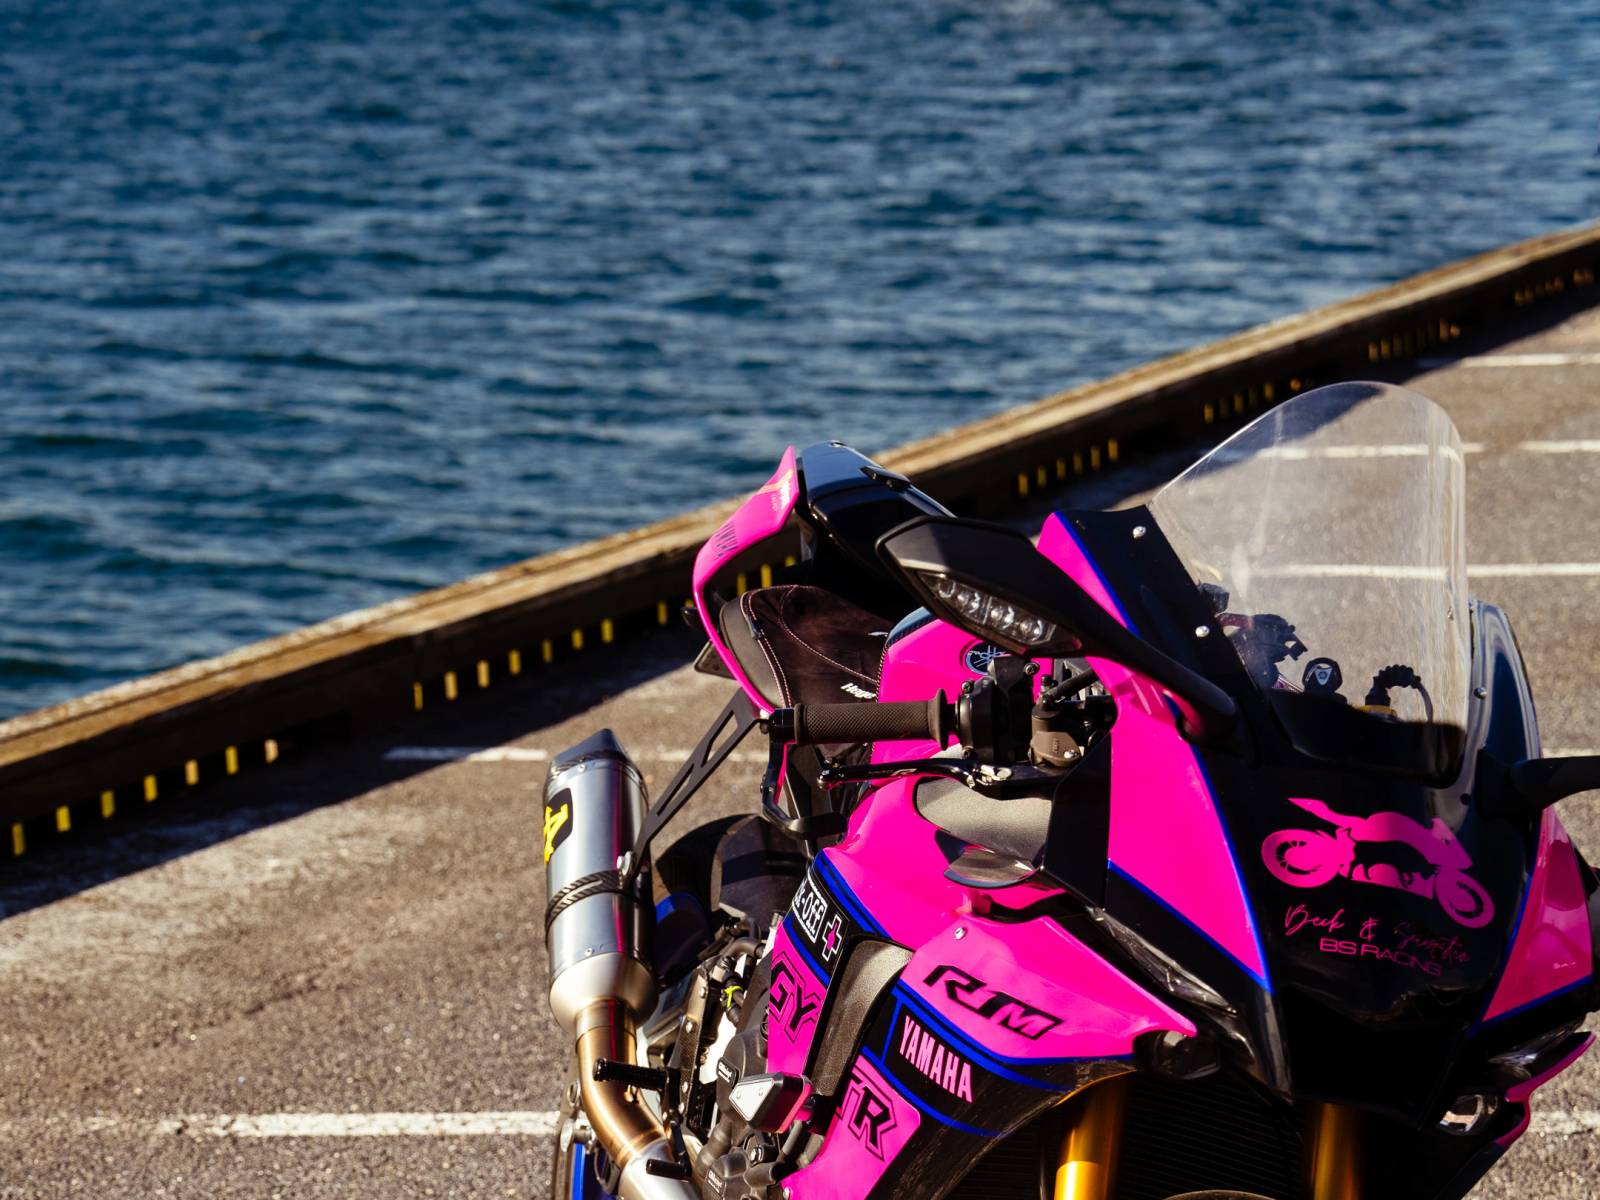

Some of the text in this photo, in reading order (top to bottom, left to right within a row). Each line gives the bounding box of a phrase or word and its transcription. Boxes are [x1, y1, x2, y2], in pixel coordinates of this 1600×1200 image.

[1359, 917, 1379, 942] &
[1319, 937, 1358, 957] BS
[899, 1014, 973, 1104] YAMAHA
